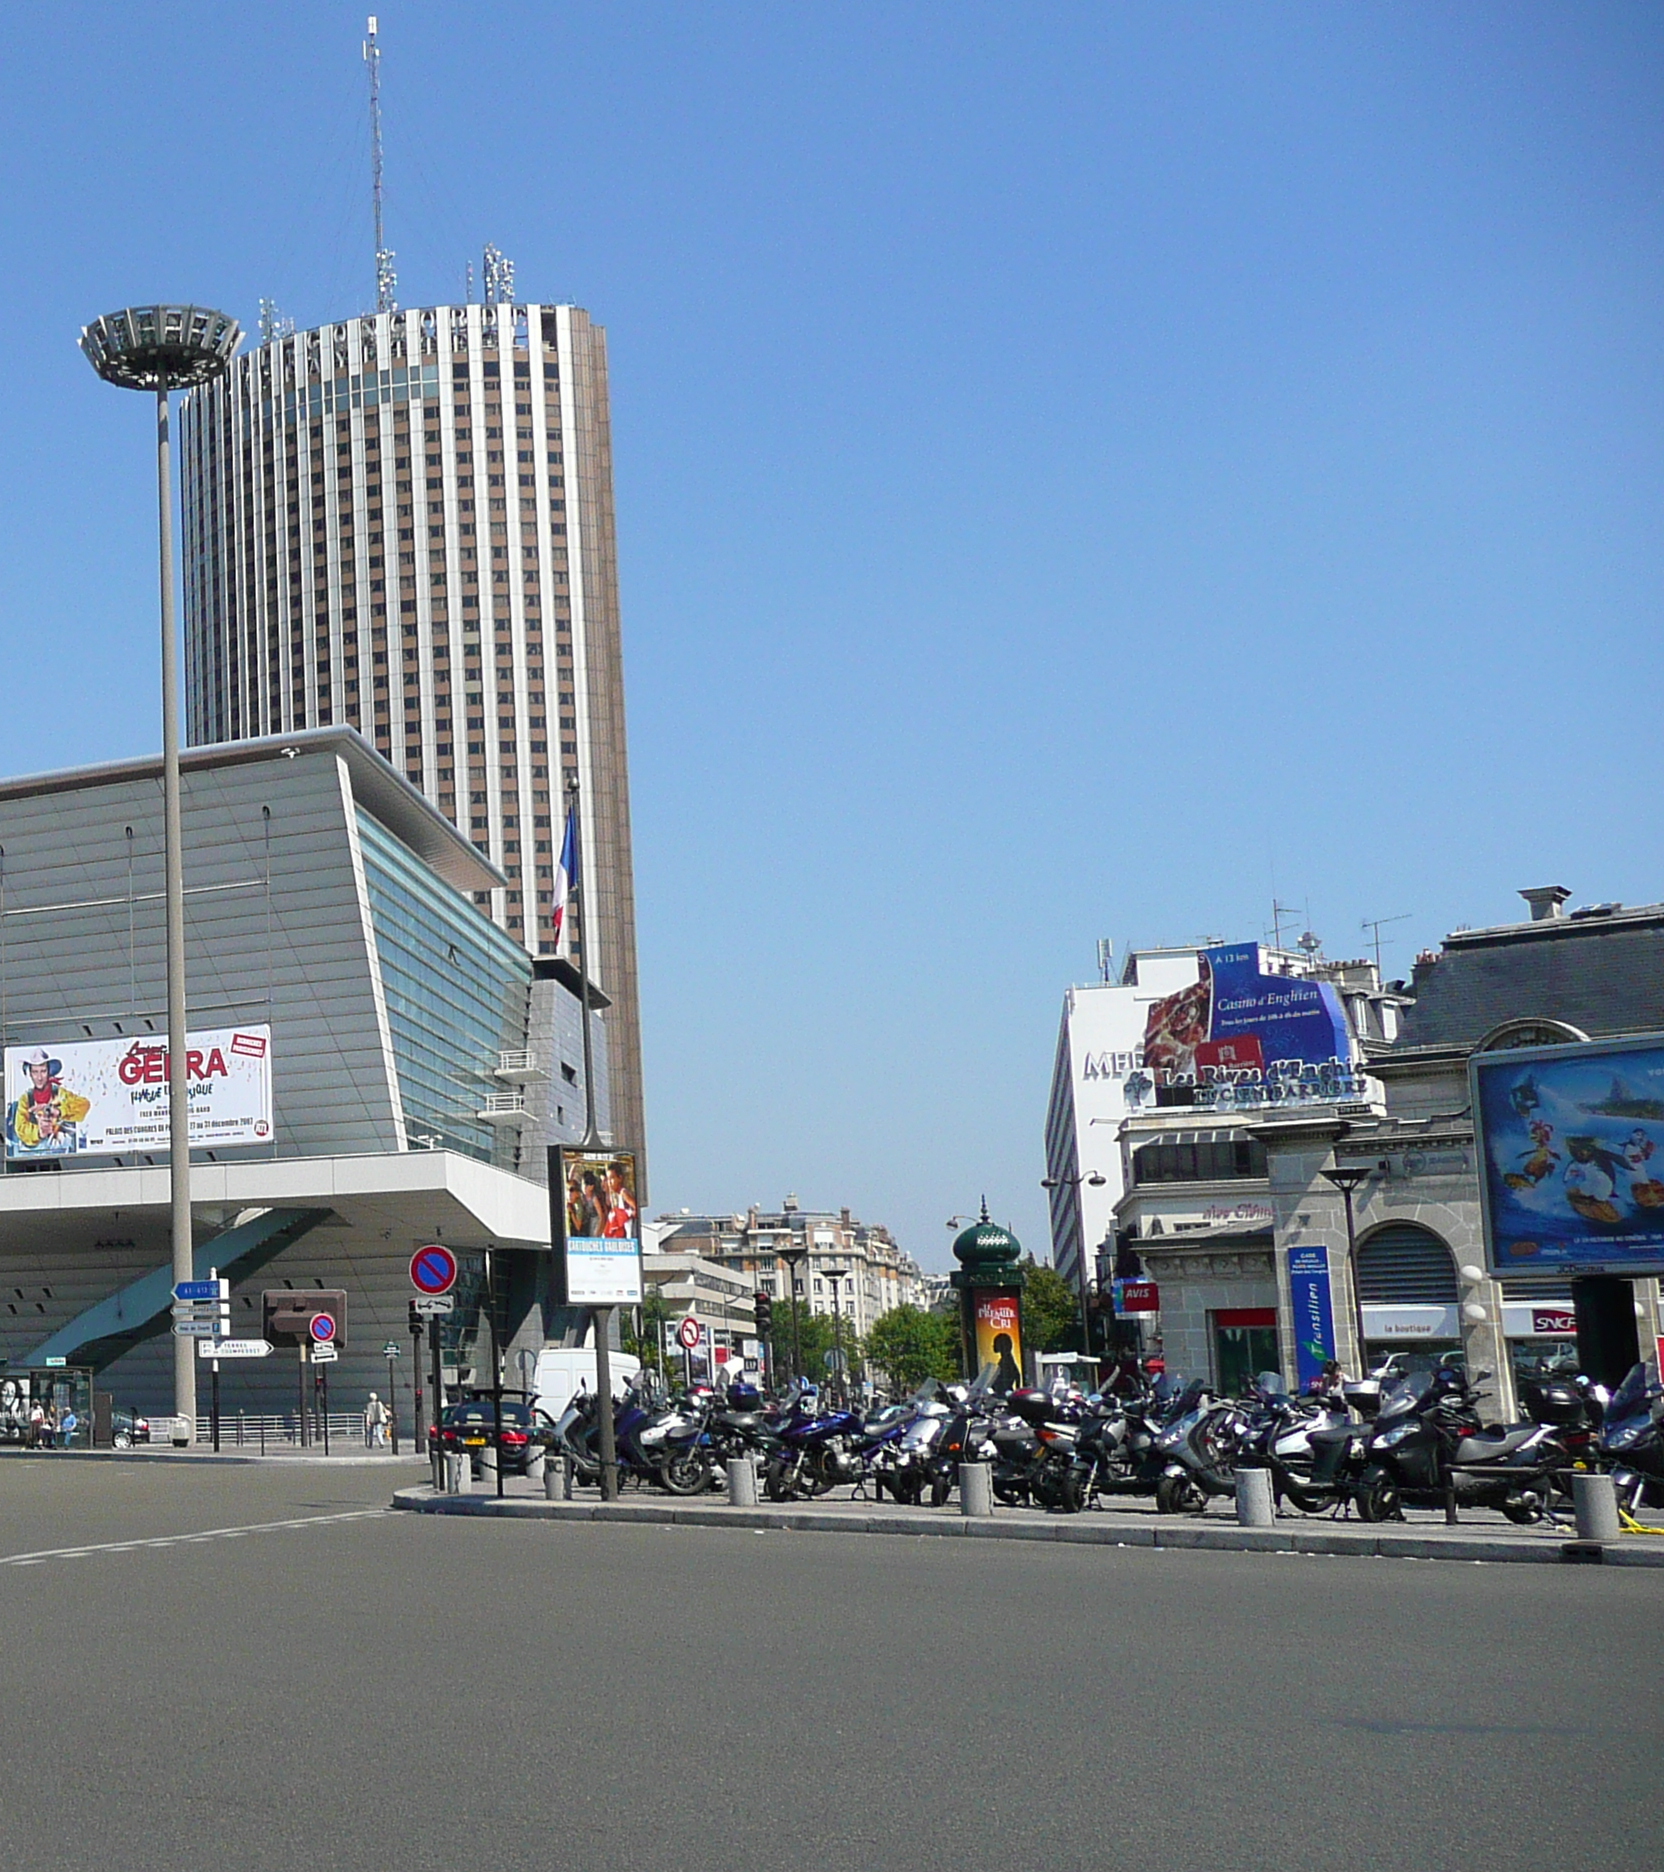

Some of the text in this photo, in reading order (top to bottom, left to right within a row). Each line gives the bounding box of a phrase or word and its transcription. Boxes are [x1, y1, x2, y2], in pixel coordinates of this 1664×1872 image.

[1225, 954, 1234, 963] 13
[1218, 998, 1256, 1011] Casino
[1159, 1066, 1196, 1088] Les
[1200, 1064, 1262, 1085] Rives
[1193, 1085, 1267, 1104] LUCIEN
[1556, 1264, 1605, 1275] JCDecaux
[1126, 1289, 1149, 1298] AVIS
[990, 1318, 1011, 1329] CRI
[1308, 1283, 1323, 1354] Transilien
[1536, 1317, 1577, 1330] SNCF
[1384, 1325, 1432, 1334] la boutique
